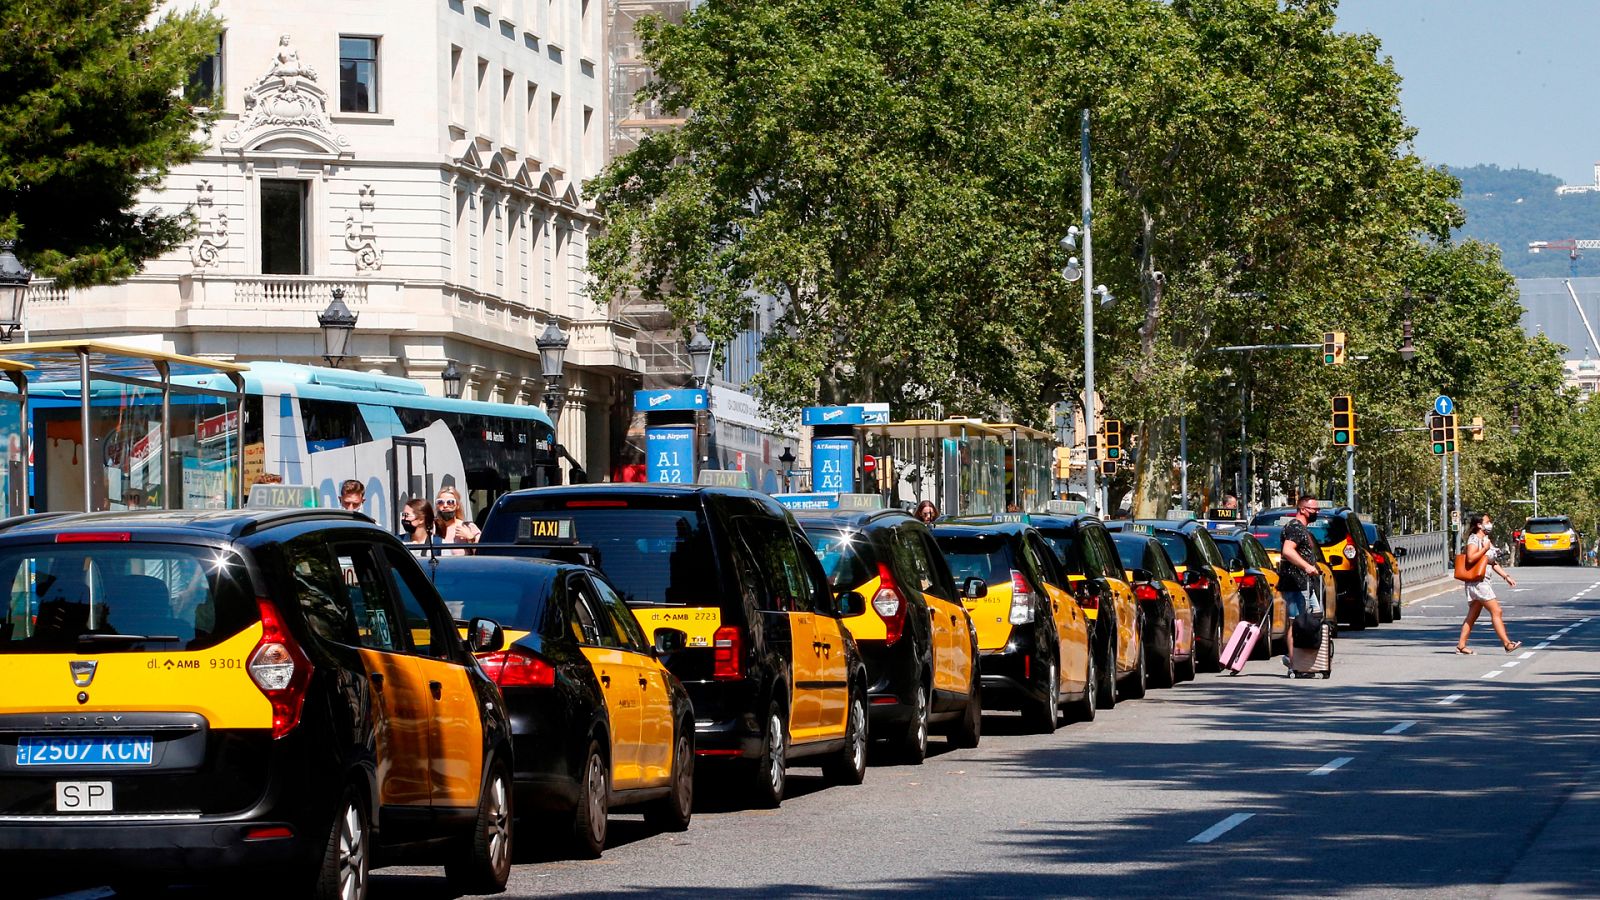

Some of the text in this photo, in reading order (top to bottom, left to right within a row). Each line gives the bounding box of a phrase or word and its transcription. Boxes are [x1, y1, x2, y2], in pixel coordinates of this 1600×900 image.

[876, 412, 888, 423] A1
[656, 452, 680, 467] A1
[821, 459, 841, 473] A1
[659, 469, 682, 483] A2
[714, 473, 737, 487] TAXI
[821, 475, 843, 489] A2
[271, 488, 302, 507] TAXI
[853, 496, 872, 508] TAXI
[1003, 515, 1021, 523] TAXI
[1217, 509, 1232, 518] TAXI
[532, 520, 558, 537] TAXI
[1133, 525, 1147, 533] TAXI
[695, 612, 717, 621] 2723
[176, 660, 200, 669] AMB
[209, 658, 243, 669] 9301
[33, 738, 149, 762] 2507 KCN
